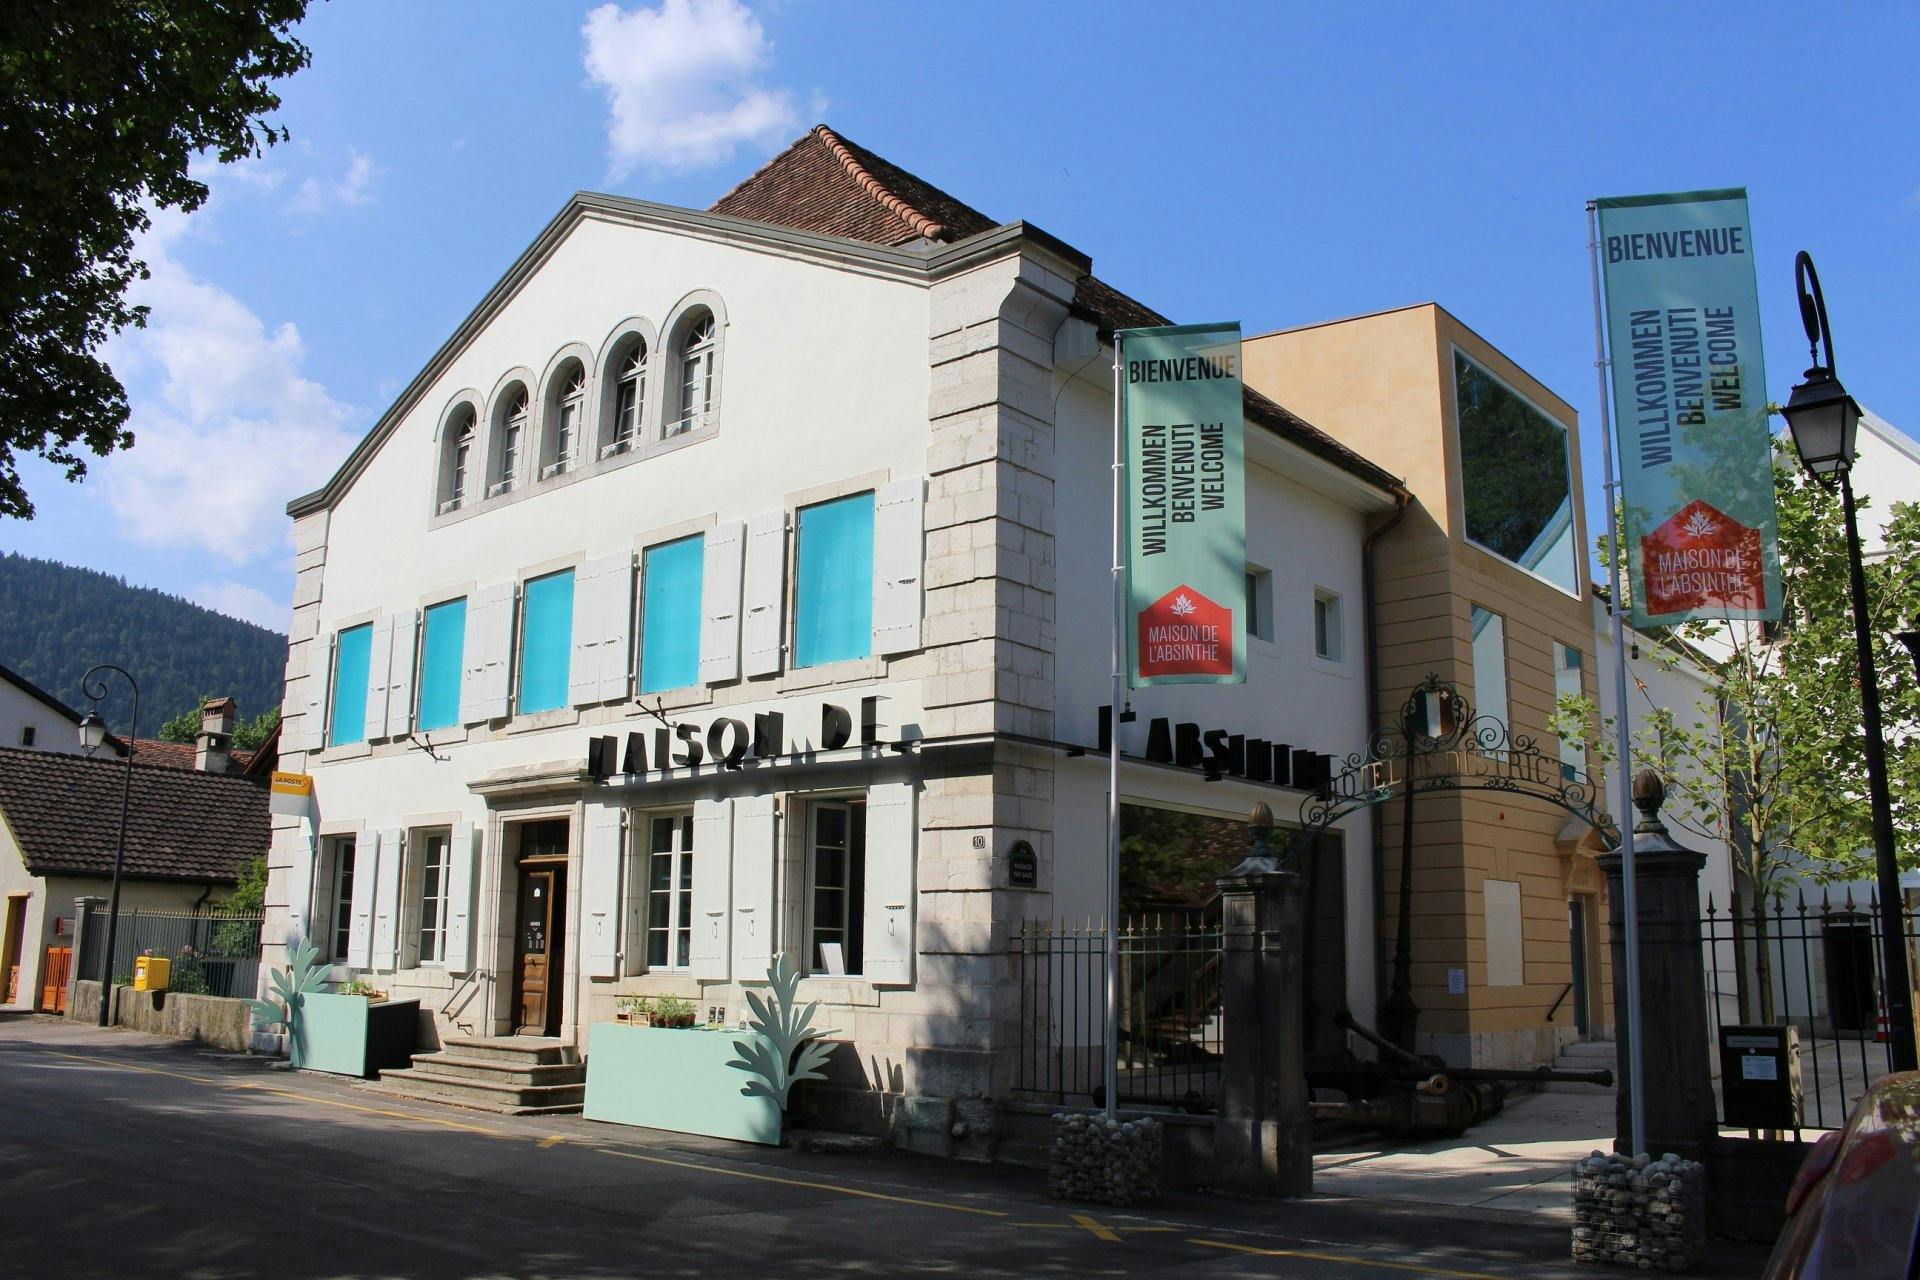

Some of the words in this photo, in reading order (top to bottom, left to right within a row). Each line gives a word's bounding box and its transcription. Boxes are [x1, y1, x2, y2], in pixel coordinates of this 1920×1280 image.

[1607, 226, 1745, 264] BIENVENUE
[1129, 355, 1235, 384] BIENVENUE
[1630, 309, 1673, 470] WILLKOMMEN
[1667, 307, 1706, 426] BENVENUTI
[1704, 305, 1742, 410] WELCOME
[1142, 424, 1167, 556] WILLKOMMEN
[1171, 423, 1195, 524] BENVENUTI
[1200, 422, 1225, 512] WELCOME
[1659, 549, 1721, 574] MAISON
[1725, 548, 1746, 569] DE
[1150, 626, 1198, 642] MAISON
[1202, 626, 1218, 641] DE
[1151, 645, 1218, 661] L'ABSINTHE
[588, 710, 784, 777] MAISON
[821, 695, 893, 750] DE
[973, 836, 983, 847] 10
